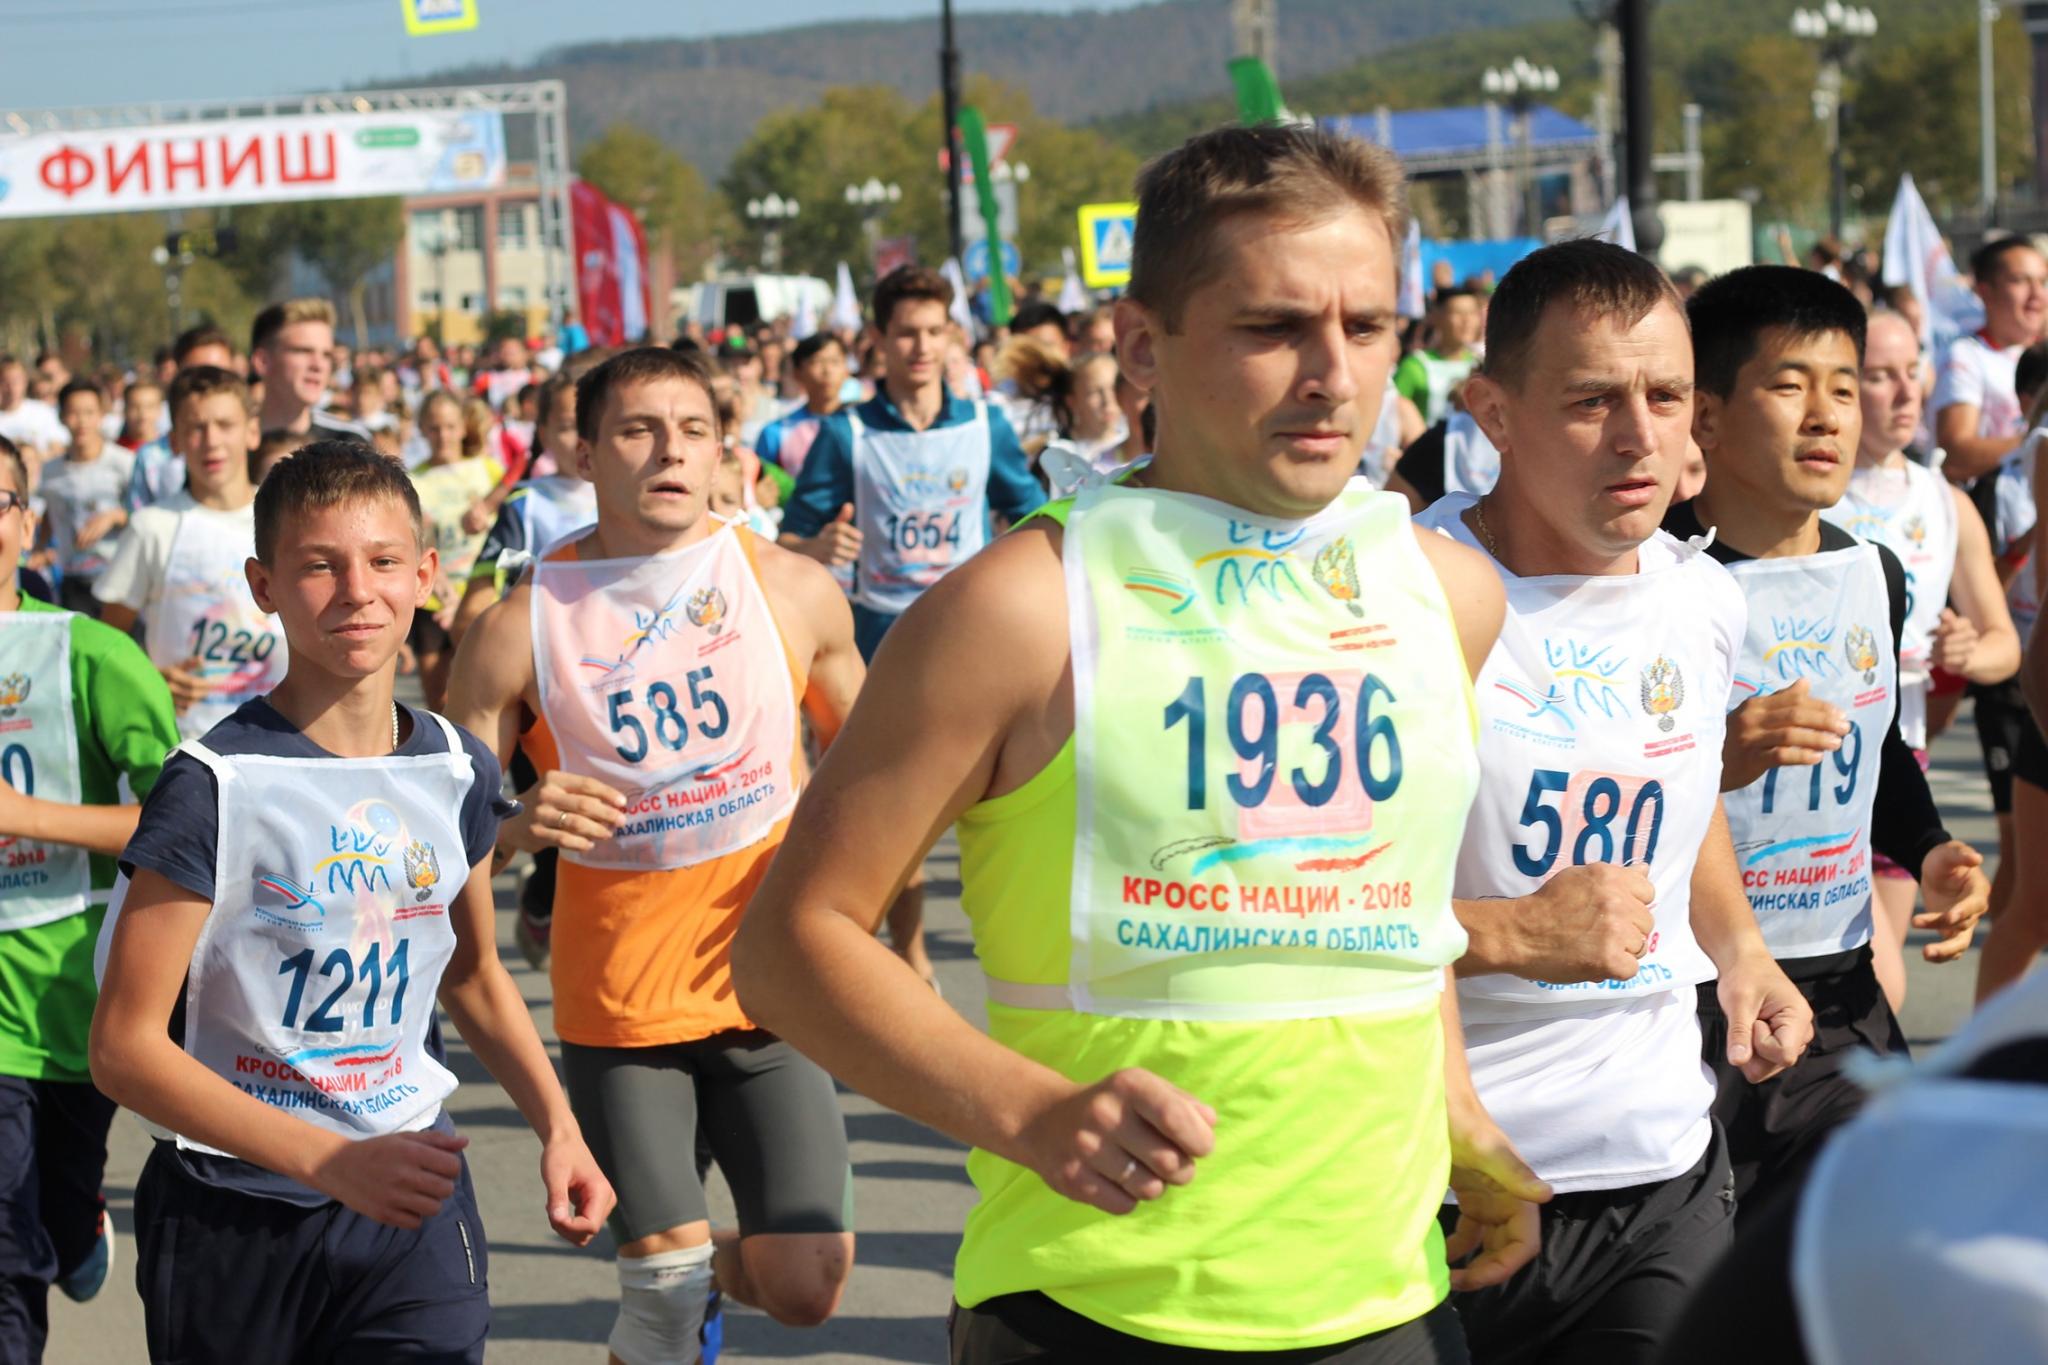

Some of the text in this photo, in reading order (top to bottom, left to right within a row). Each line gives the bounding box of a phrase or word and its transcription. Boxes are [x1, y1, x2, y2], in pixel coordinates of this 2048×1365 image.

[38, 131, 339, 199] ФИНИШ
[886, 510, 961, 552] 1654
[192, 617, 276, 664] 1220
[607, 665, 729, 763] 585
[1164, 672, 1403, 810] 1936
[666, 781, 728, 808] НАЦИИ
[740, 761, 772, 788] 2018
[617, 783, 775, 837] АХАЛИНСКАЯ ОБЛАСТЬ
[1512, 769, 1664, 877] 580
[0, 870, 48, 888] ЛАСТЬ
[8, 850, 45, 867] 2018
[1774, 864, 1837, 886] НАЦИИ
[1122, 875, 1230, 912] КРОСС
[1239, 885, 1340, 918] НАЦИИ
[1362, 882, 1412, 910] 2018
[1747, 892, 1820, 910] ИНСКАЯ
[1117, 919, 1419, 951] САХАЛИНСКАЯ ОБЛАСТЬ
[279, 938, 410, 1033] 1211
[235, 1055, 306, 1082] КРОСС
[310, 1072, 366, 1093] НАЦИИ
